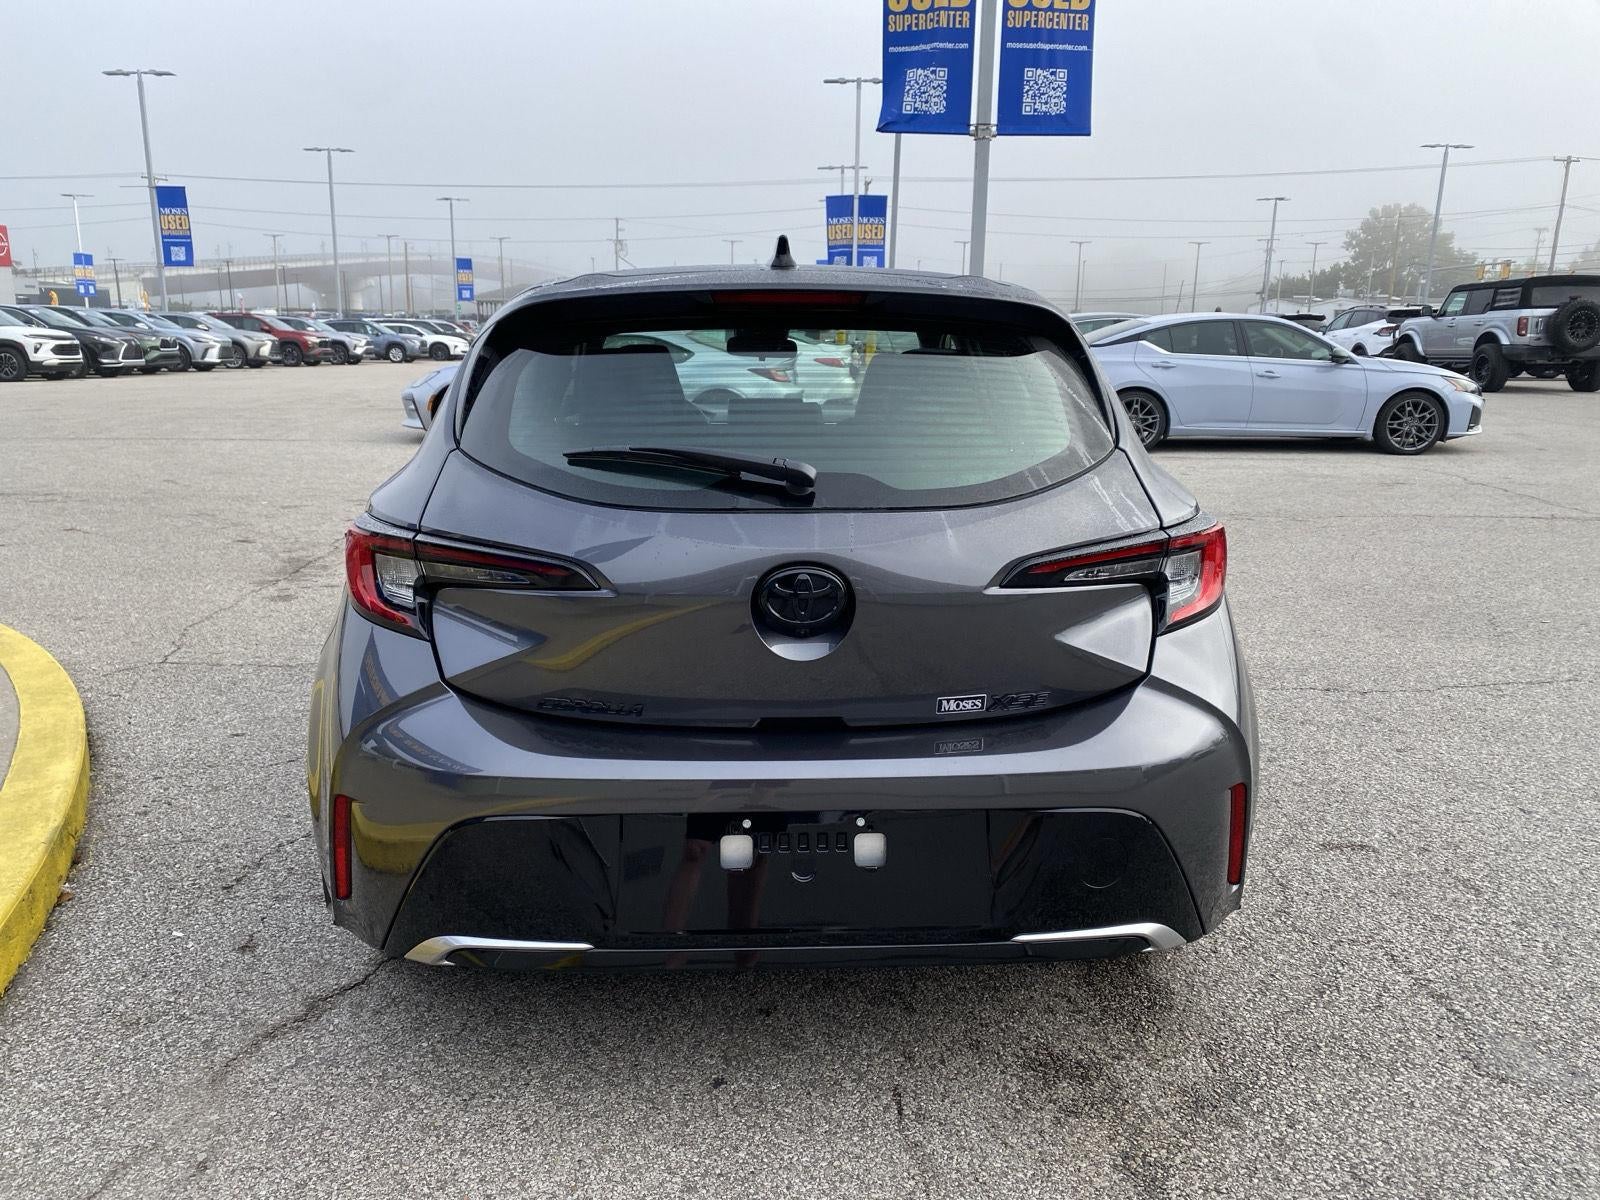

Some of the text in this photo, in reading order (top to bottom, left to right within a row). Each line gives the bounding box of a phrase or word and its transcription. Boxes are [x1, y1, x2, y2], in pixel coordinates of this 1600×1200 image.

[888, 10, 970, 32] SUPERCENTER
[1007, 10, 1089, 31] SUPERCENTER
[888, 42, 969, 53] mosesusedsupercenter.com
[1006, 42, 1088, 51] mosesusedsupercenter.com
[160, 207, 187, 215] MOSES
[160, 215, 189, 230] USED
[858, 216, 885, 224] MOSES
[828, 225, 853, 239] USED
[858, 224, 884, 239] USED
